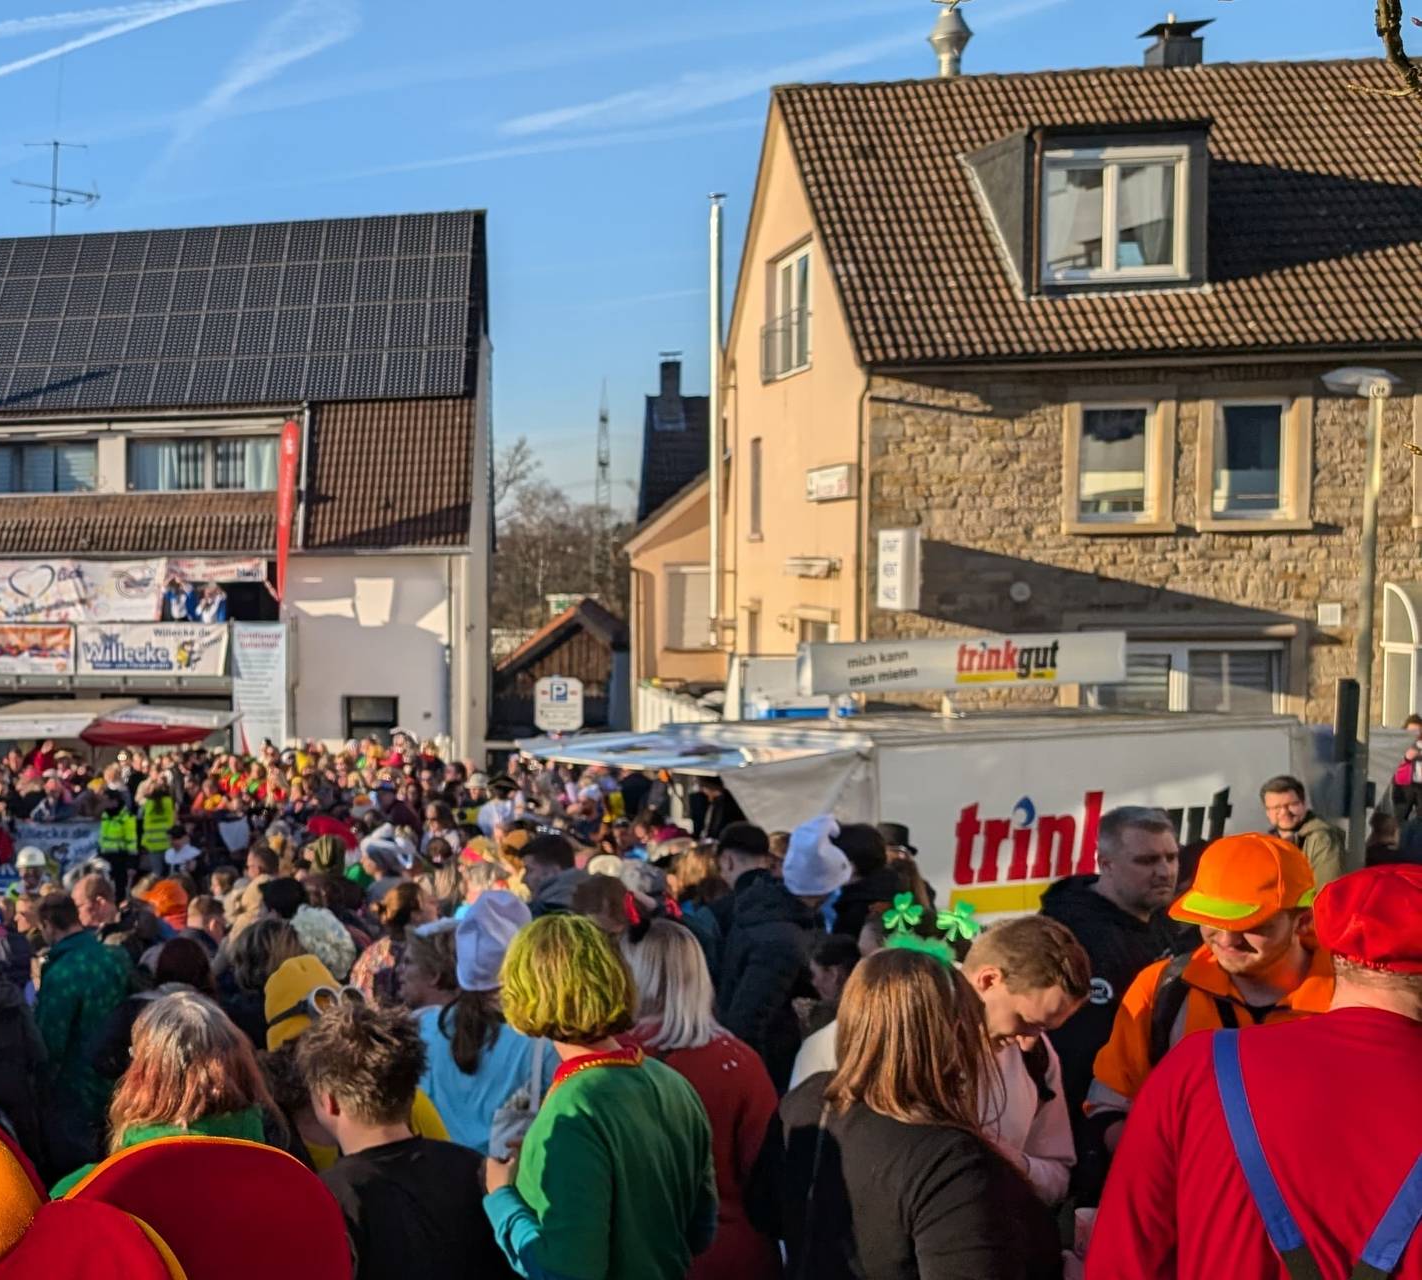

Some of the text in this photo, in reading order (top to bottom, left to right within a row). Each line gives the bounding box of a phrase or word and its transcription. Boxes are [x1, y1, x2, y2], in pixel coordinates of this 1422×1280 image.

[82, 640, 170, 664] Willecke
[847, 650, 908, 669] mich kann
[956, 639, 1059, 679] trinkgut
[848, 666, 918, 688] man mieten
